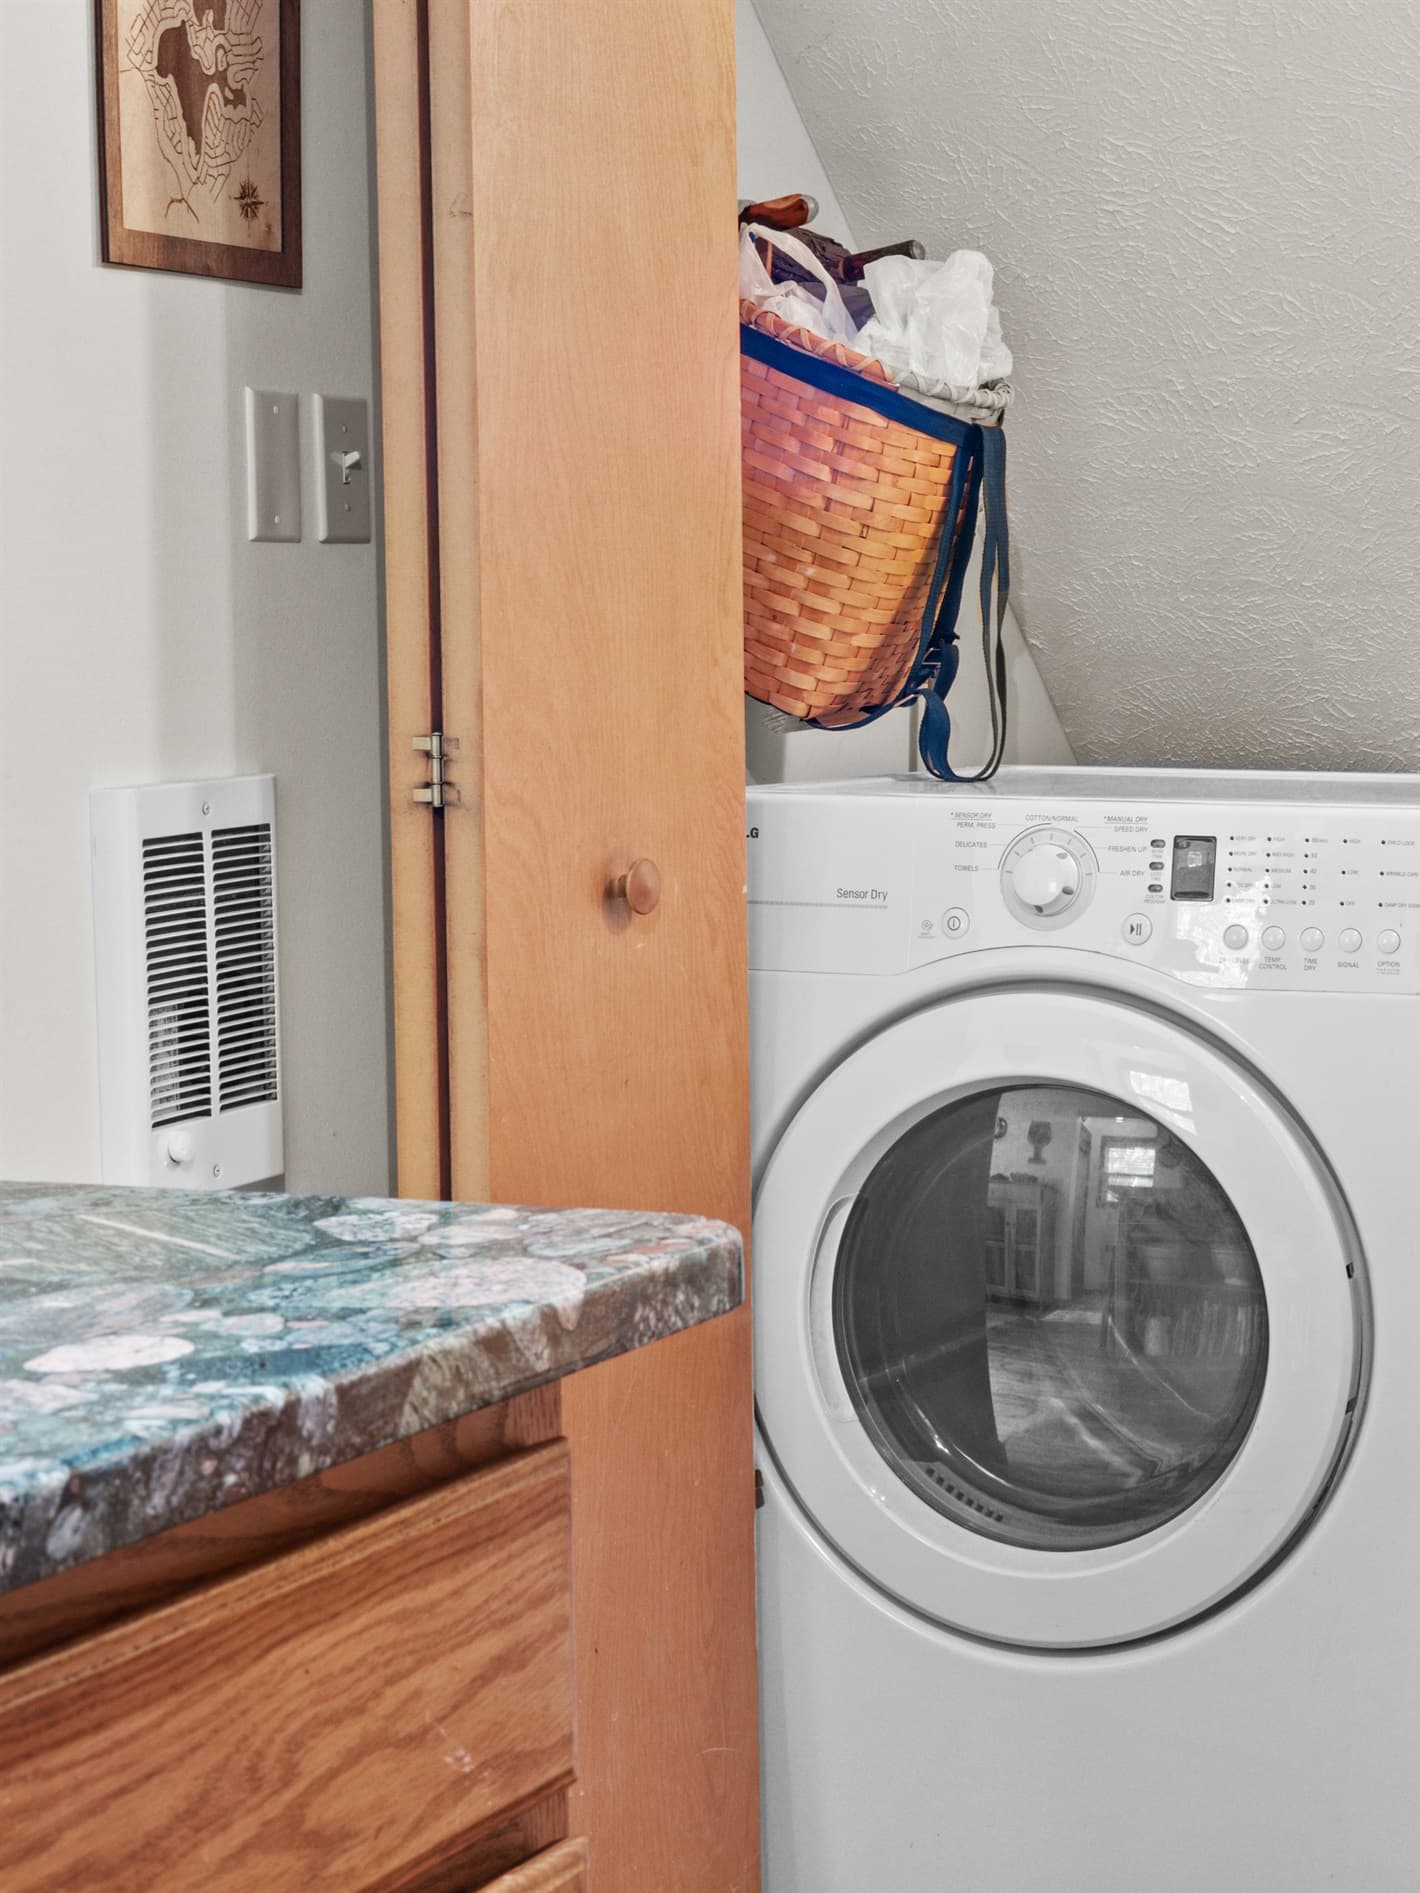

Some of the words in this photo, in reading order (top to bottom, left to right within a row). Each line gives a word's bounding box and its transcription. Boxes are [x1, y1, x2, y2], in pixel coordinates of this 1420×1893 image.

[1024, 814, 1078, 823] COTTON/NORMAL
[1135, 815, 1148, 823] DRY
[976, 821, 997, 829] PRESS
[1114, 825, 1134, 833] SPEED
[1135, 825, 1148, 833] DRY
[746, 827, 759, 838] G
[955, 840, 988, 849] DELICATES
[1107, 845, 1137, 853] FRESHEN
[1138, 845, 1147, 853] UP
[953, 864, 979, 872] TOWELS
[836, 887, 868, 899] Sensor
[870, 888, 888, 902] Dry
[1303, 957, 1318, 965] TIME
[1337, 961, 1360, 969] SIGNAL
[1377, 960, 1400, 968] OPTION
[1303, 964, 1316, 972] DRY
